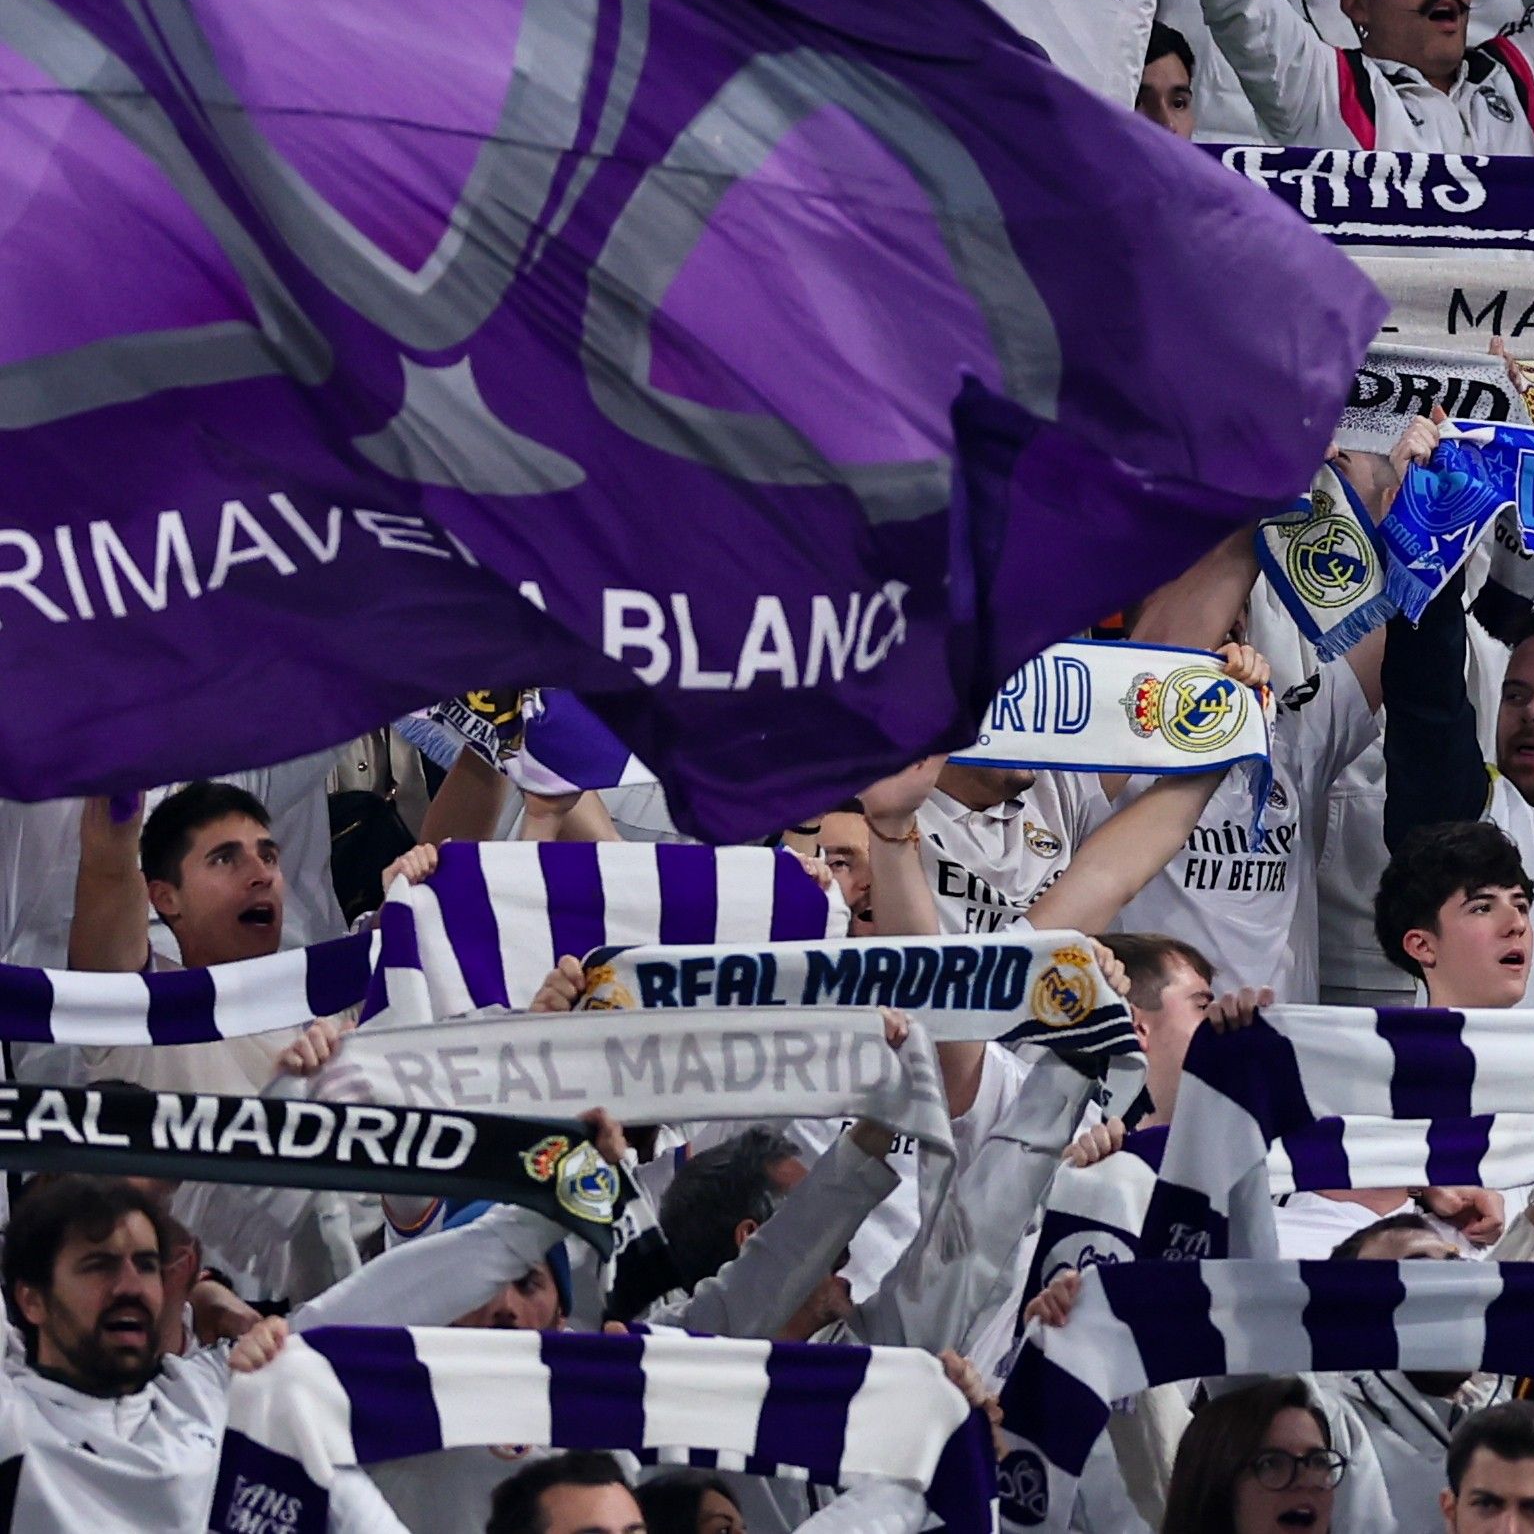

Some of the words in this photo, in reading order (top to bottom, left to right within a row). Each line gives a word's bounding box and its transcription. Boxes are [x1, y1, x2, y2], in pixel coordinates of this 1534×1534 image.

[1220, 144, 1491, 217] FANS
[1183, 859, 1219, 890] FLY
[1228, 860, 1288, 891] BETTER
[636, 958, 792, 1012] REAL
[801, 946, 1034, 1011] MADRID
[384, 1042, 588, 1108] REAL
[152, 1094, 479, 1171] MADRID
